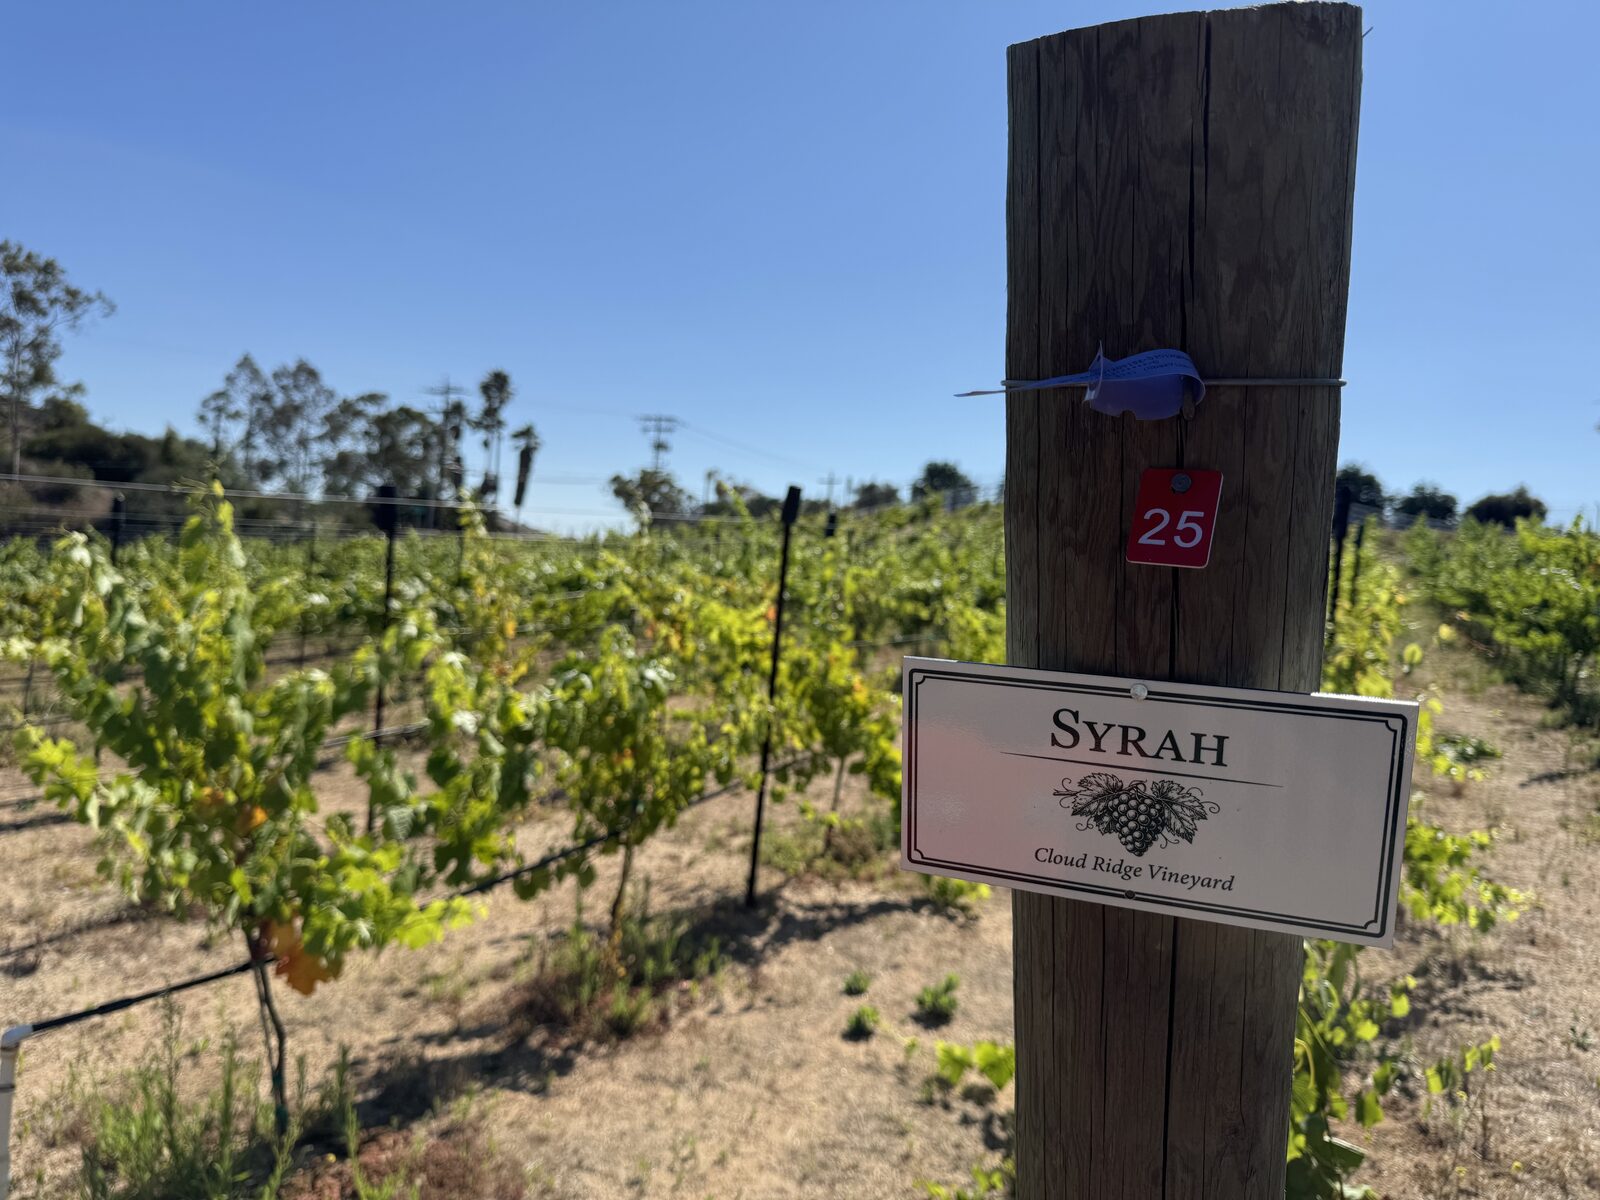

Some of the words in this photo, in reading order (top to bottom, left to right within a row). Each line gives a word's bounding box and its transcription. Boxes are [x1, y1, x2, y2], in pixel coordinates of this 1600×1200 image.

[1137, 507, 1205, 549] 25
[1050, 708, 1229, 767] SYRAH
[1034, 847, 1087, 869] Cloud
[1092, 856, 1143, 880] Ridge
[1148, 864, 1235, 891] Vineyard
